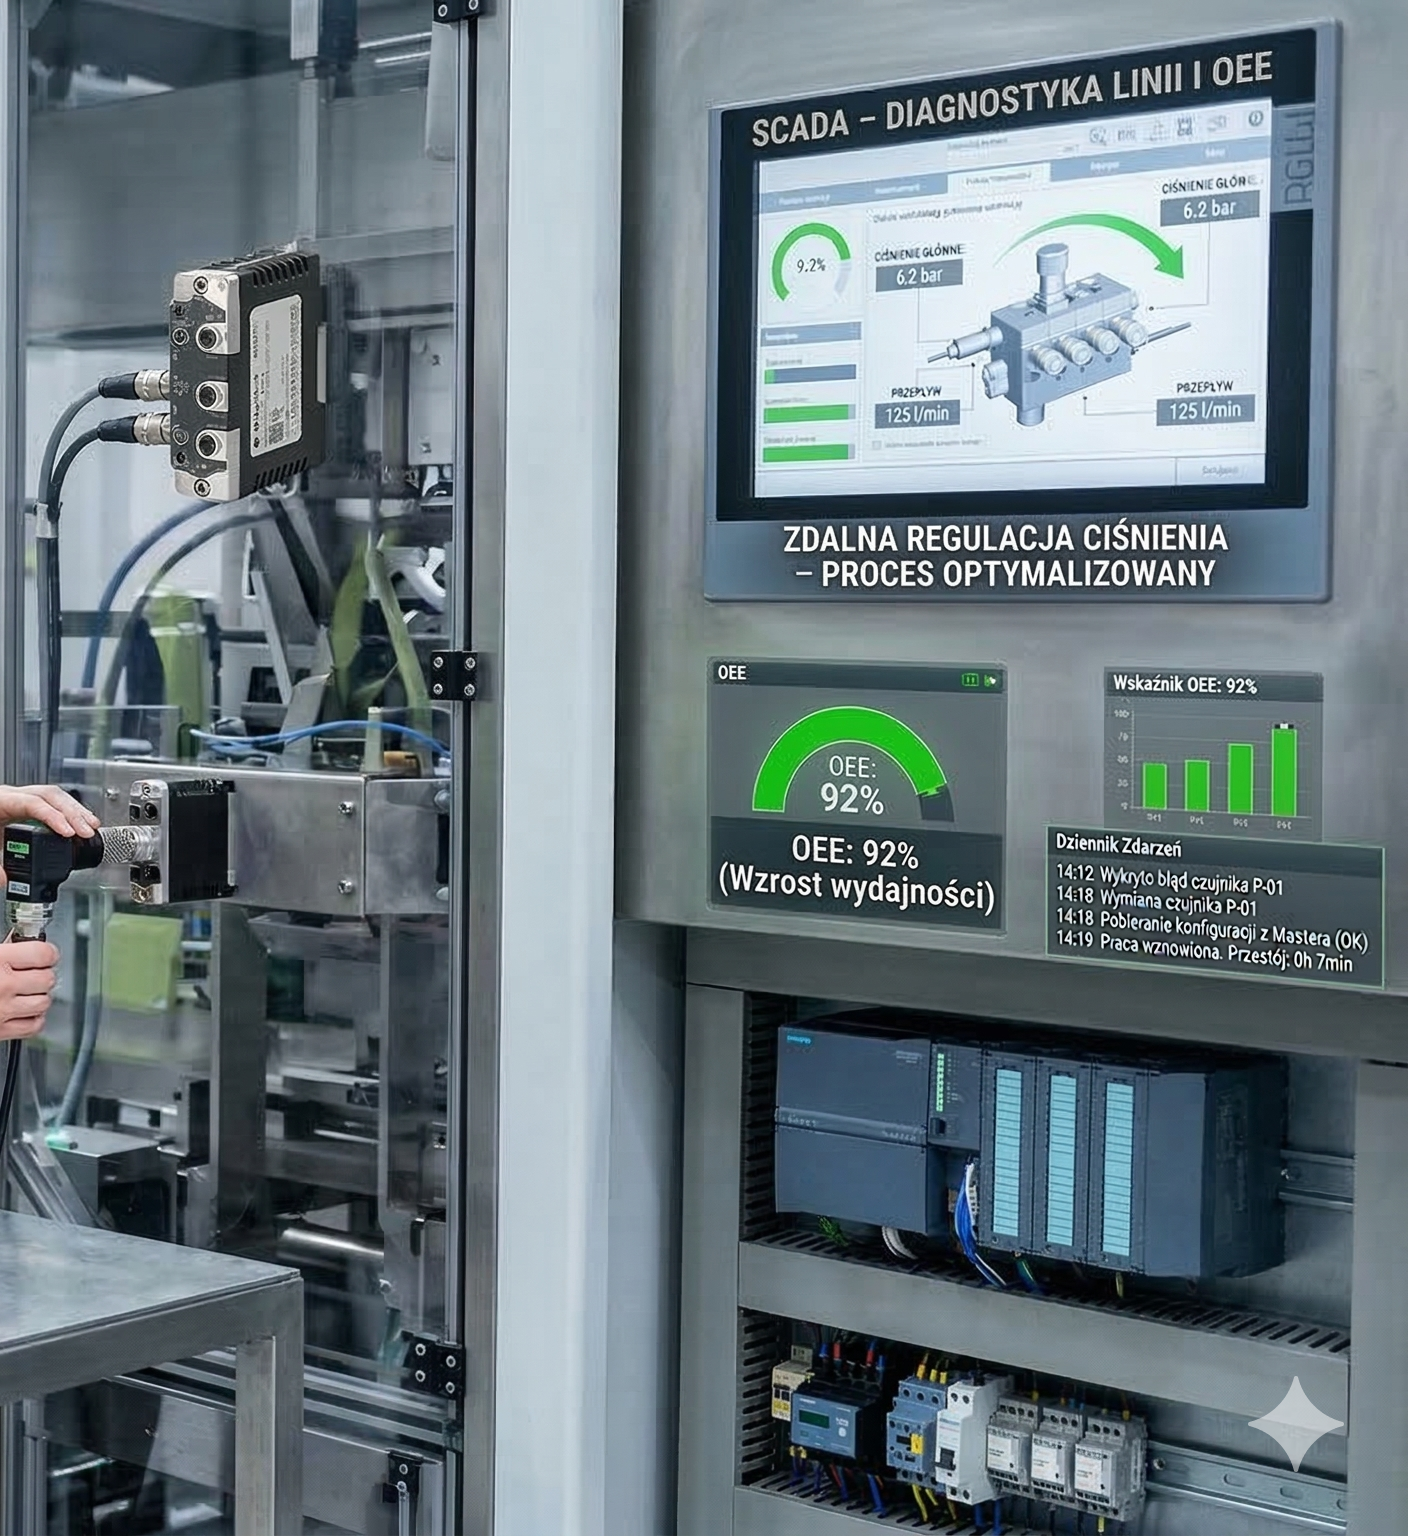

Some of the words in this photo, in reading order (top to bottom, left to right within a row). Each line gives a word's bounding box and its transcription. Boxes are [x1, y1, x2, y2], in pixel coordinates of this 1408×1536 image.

[752, 108, 849, 147] SCADA
[886, 75, 1104, 130] DIAGNOSTYKA
[1113, 62, 1182, 100] LINII
[1194, 60, 1201, 90] I
[1212, 50, 1273, 87] OEE
[1212, 198, 1237, 217] bar
[921, 266, 943, 284] bar
[885, 406, 911, 423] 125
[914, 404, 949, 424] l/min
[1170, 402, 1198, 420] 125
[1202, 400, 1241, 419] l/min
[783, 525, 898, 552] ZDALNA
[907, 524, 1074, 552] REGULACJA
[1083, 518, 1229, 551] CIŚNIENIA
[822, 560, 934, 588] PROCES
[943, 559, 1217, 588] OPTYMALIZOWANY
[718, 665, 747, 680] OEE
[1113, 674, 1184, 692] Wskaźnik
[1187, 676, 1222, 693] OEE:
[1226, 678, 1258, 695] 92%
[829, 755, 876, 778] OEE:
[820, 783, 884, 815] 92%
[792, 835, 853, 864] OEE:
[862, 839, 919, 870] 92%
[1056, 833, 1119, 853] Dziennik
[1122, 837, 1182, 858] Zdarzeń
[719, 861, 822, 896] (Wzrost
[831, 874, 995, 916] wydajności)
[1057, 863, 1094, 881] 14:12
[1191, 874, 1249, 896] czujnika
[1253, 877, 1283, 896] P-01
[1057, 885, 1094, 903] 14:18
[1100, 889, 1162, 910] Wymiana
[1165, 896, 1222, 916] czujnika
[1227, 899, 1256, 917] P-01
[1057, 908, 1094, 926] 14:18
[1260, 928, 1269, 942] z
[1273, 926, 1331, 948] Mastera
[1335, 929, 1369, 955] (OK)
[1057, 930, 1094, 947] 14:19
[1101, 933, 1139, 952] Praca
[1142, 941, 1223, 960] wznowiona.
[1228, 945, 1291, 971] Przestój:
[1294, 951, 1312, 969] 0h
[1316, 953, 1353, 972] 7min
